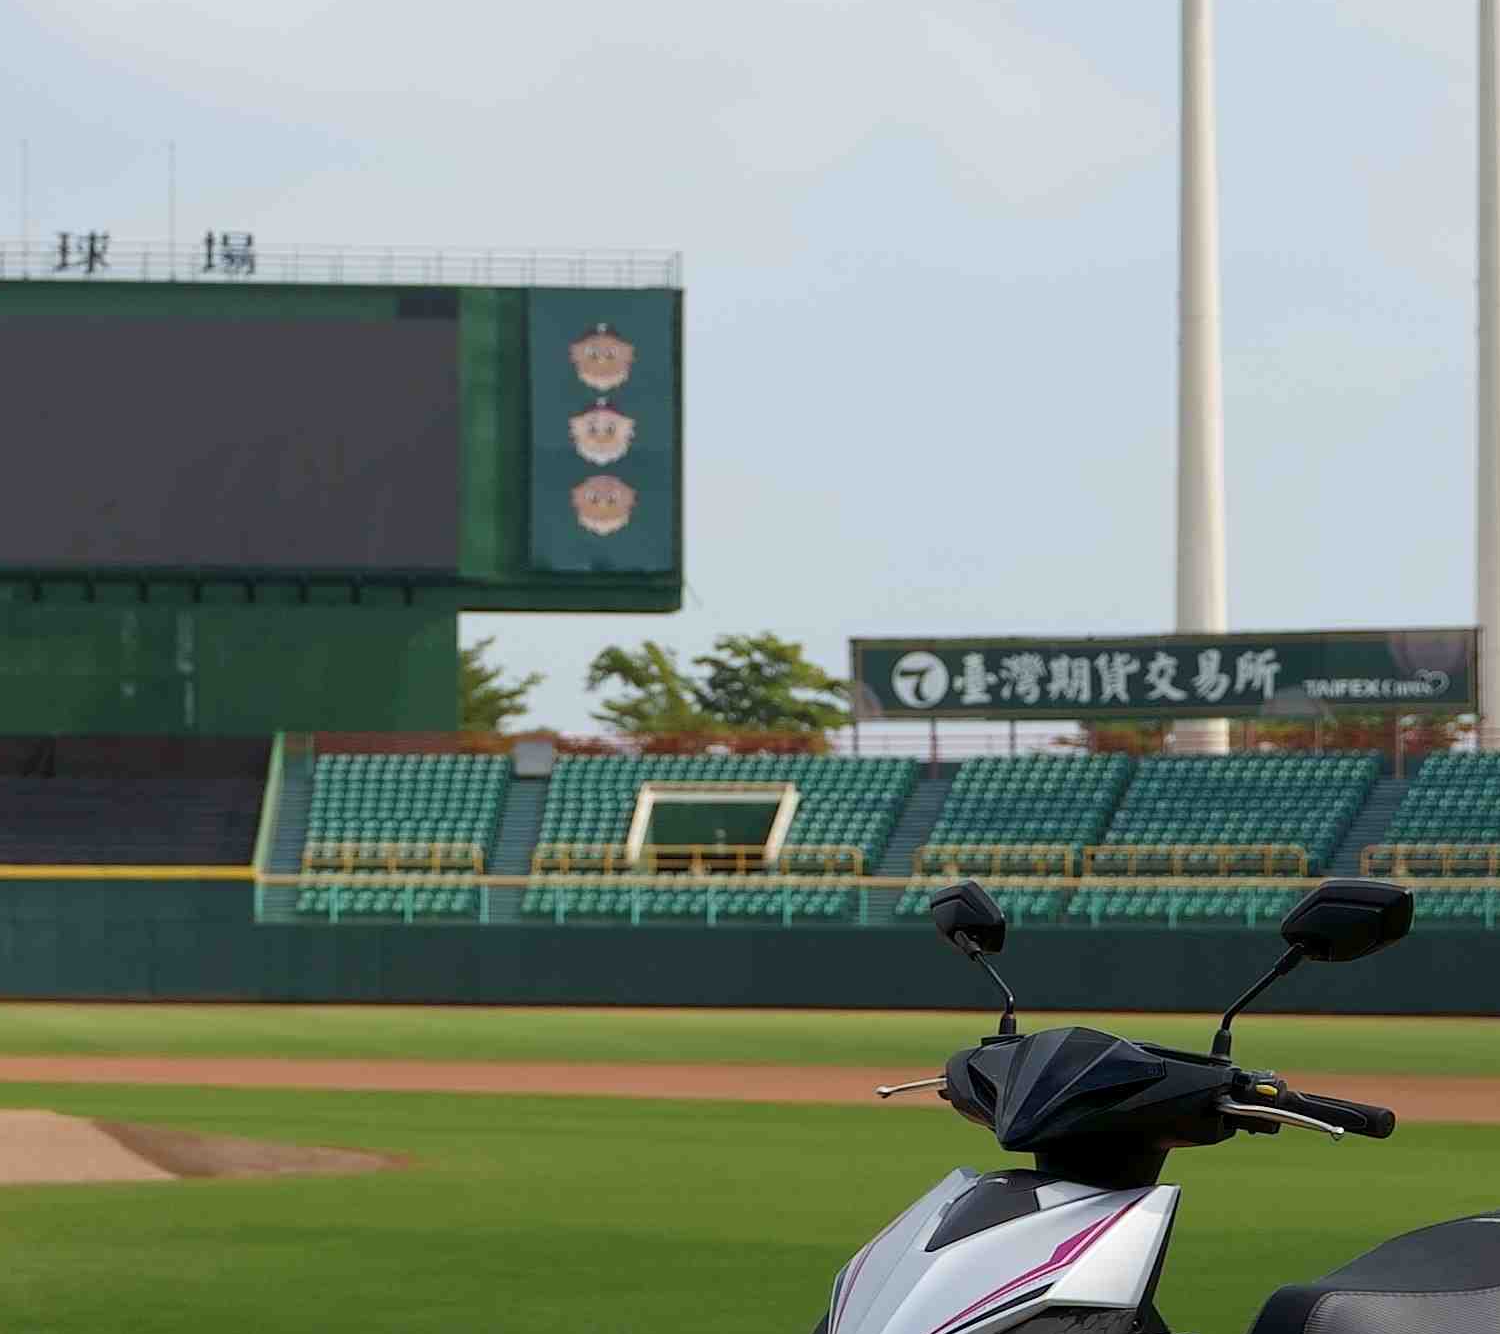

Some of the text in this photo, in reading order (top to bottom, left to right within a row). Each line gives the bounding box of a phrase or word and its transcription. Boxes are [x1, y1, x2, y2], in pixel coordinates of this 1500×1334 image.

[952, 648, 1282, 705] 臺灣期貨交易所
[1302, 678, 1380, 699] TAIFEX
